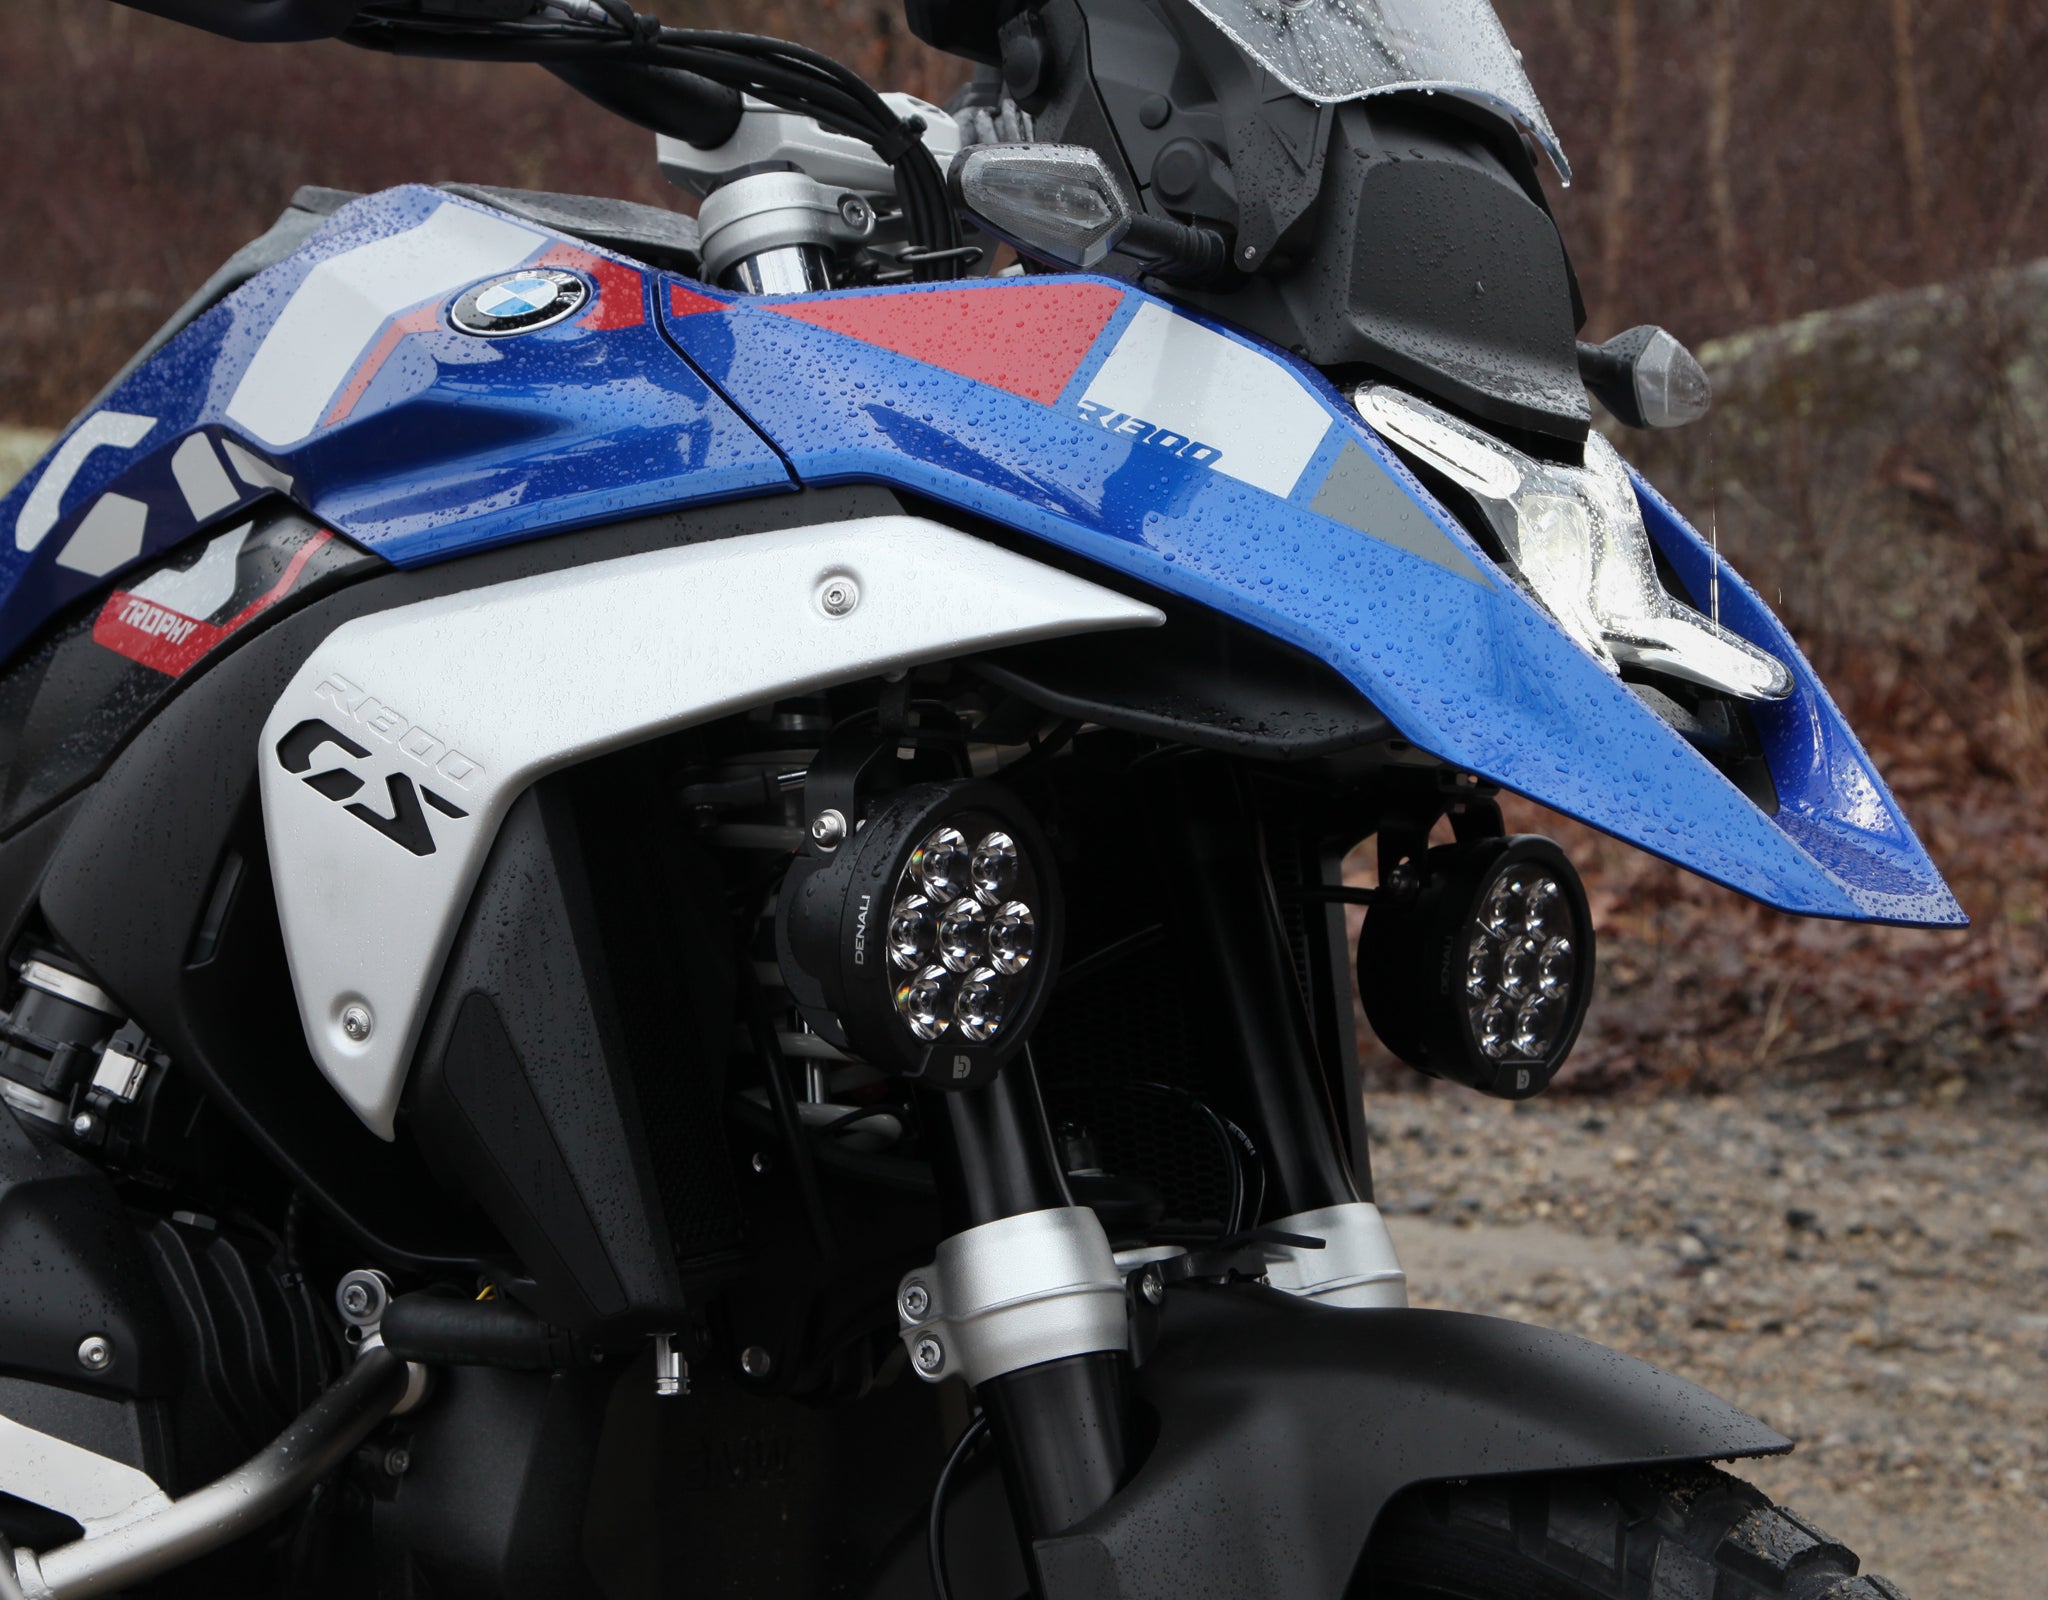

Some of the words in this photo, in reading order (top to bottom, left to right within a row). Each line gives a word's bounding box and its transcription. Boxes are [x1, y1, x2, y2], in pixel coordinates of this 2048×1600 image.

[117, 600, 199, 647] TROPHY
[275, 718, 470, 858] GS
[854, 894, 871, 965] DENALI
[1440, 935, 1454, 995] DENALI
